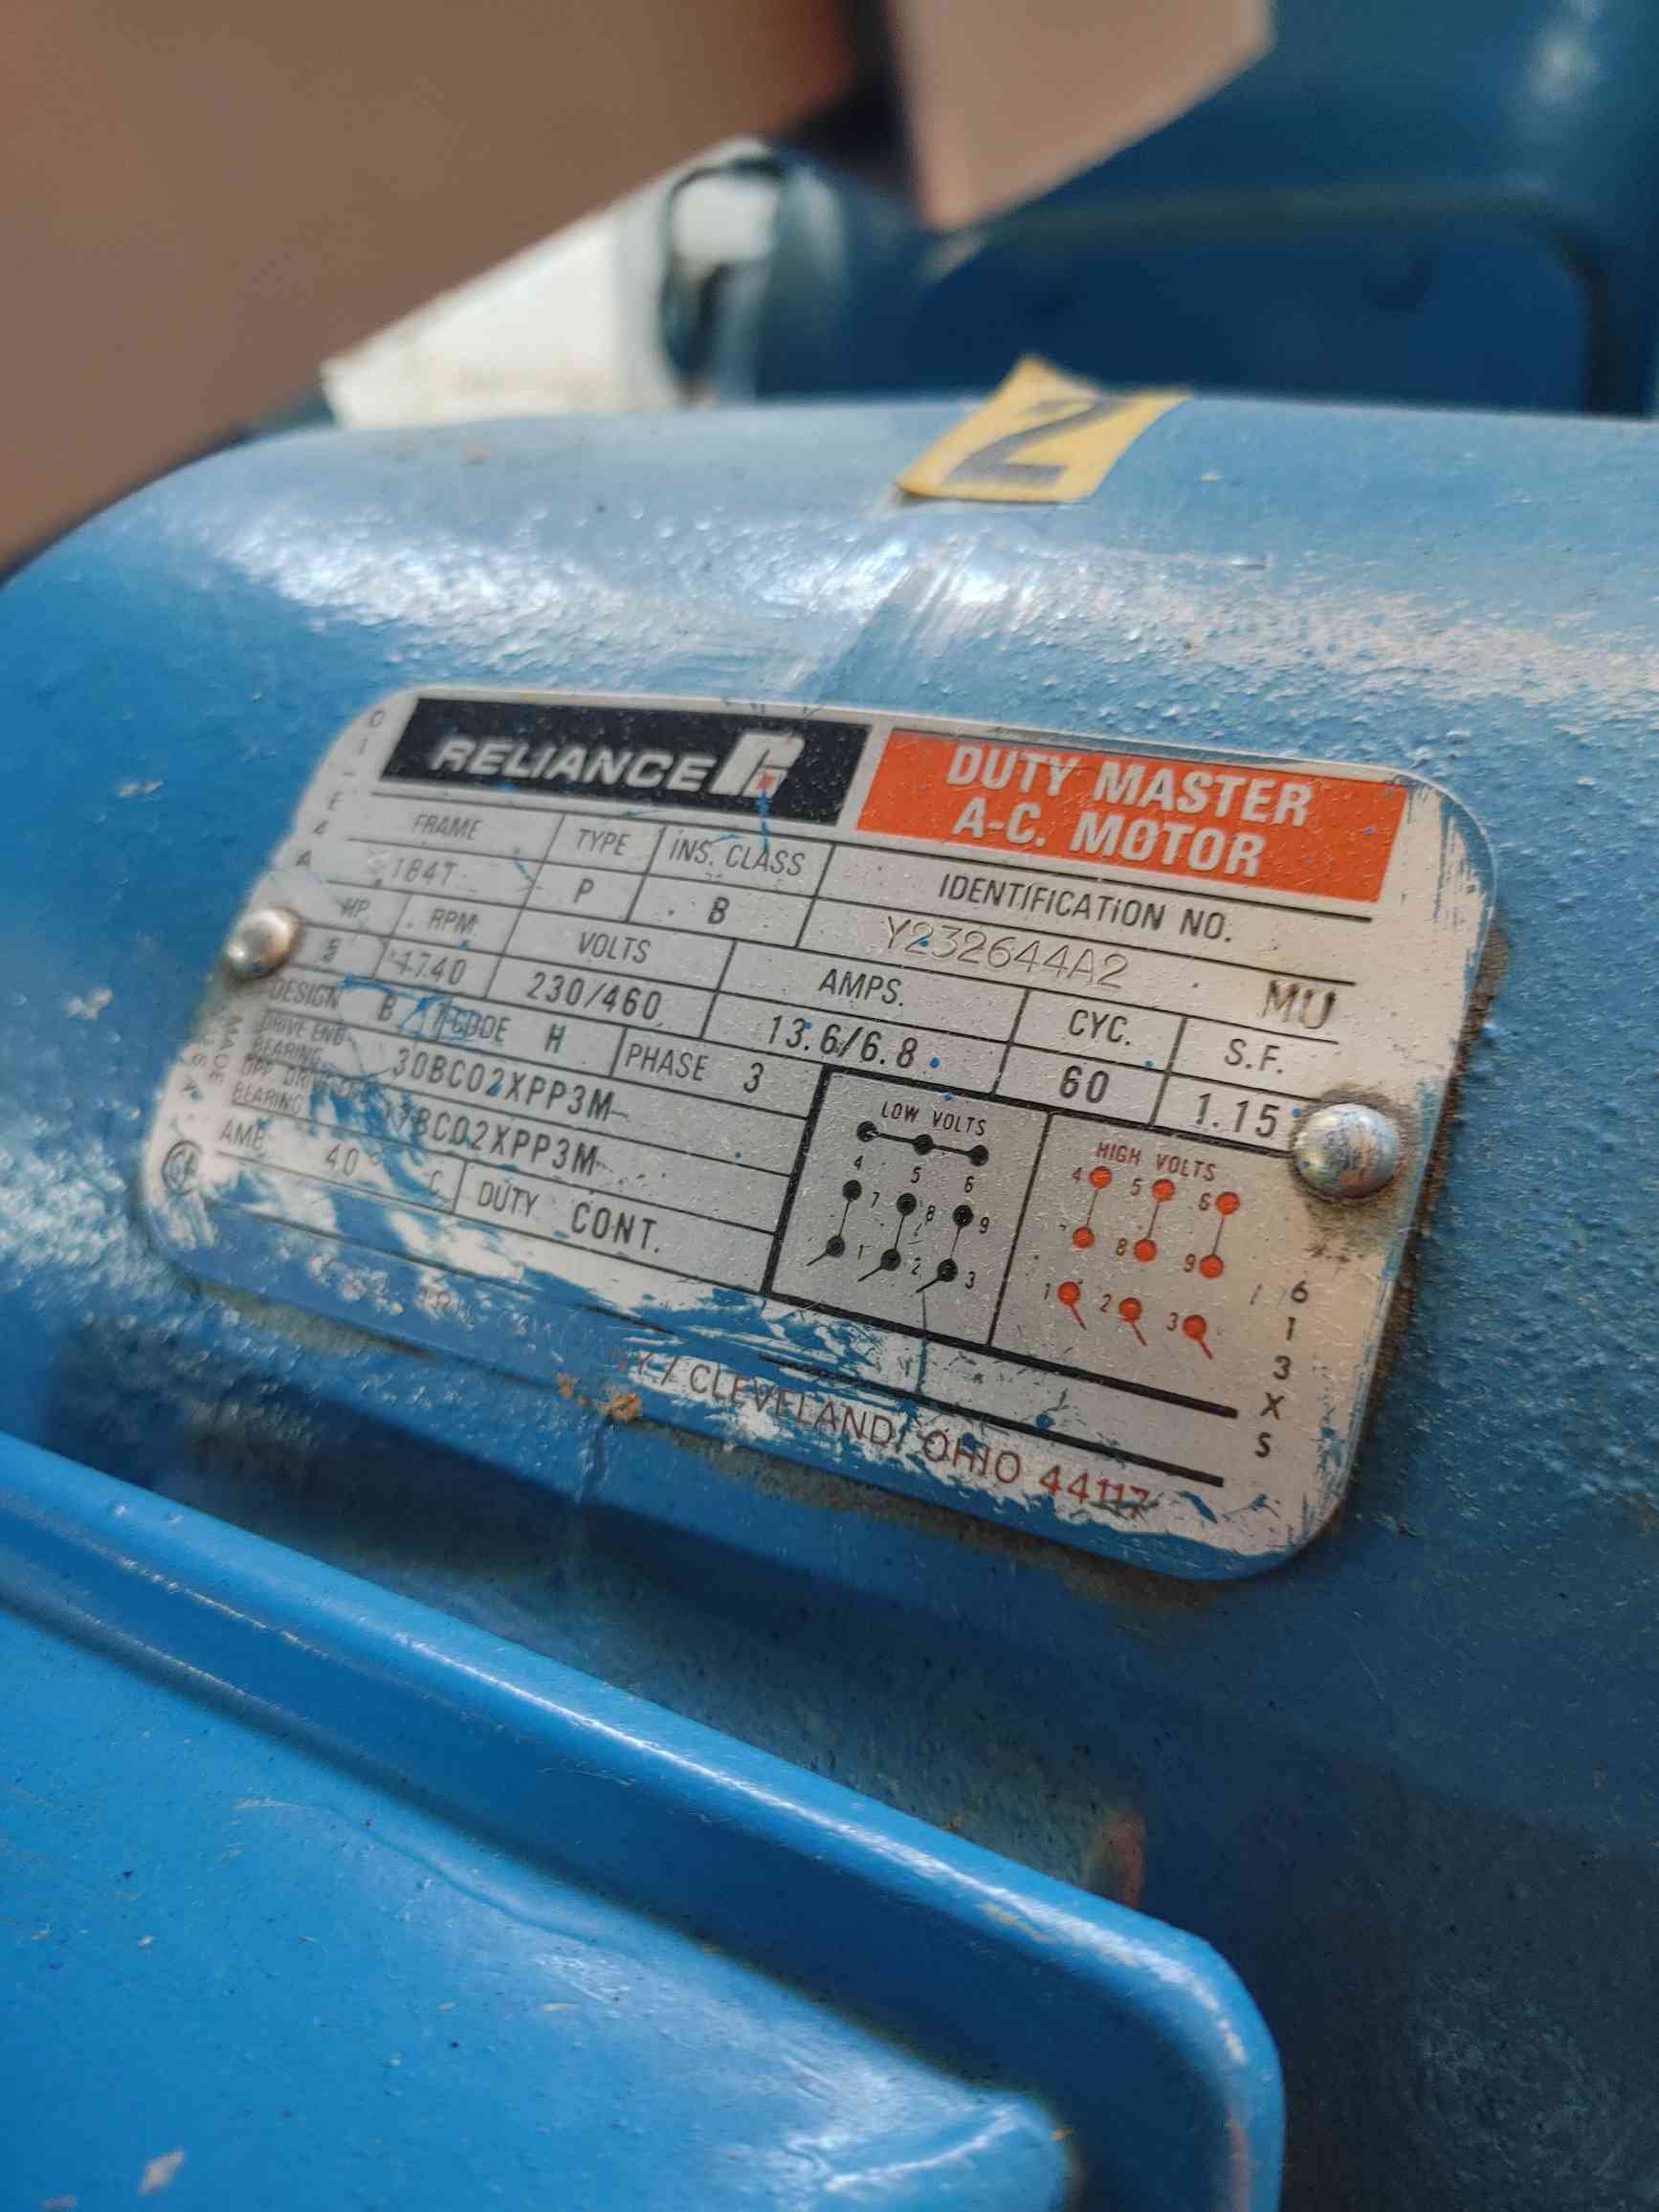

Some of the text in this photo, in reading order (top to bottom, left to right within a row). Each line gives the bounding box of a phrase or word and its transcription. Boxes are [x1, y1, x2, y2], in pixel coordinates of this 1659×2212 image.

[431, 740, 718, 793] RELIANCE
[946, 745, 1314, 829] DUTY MASTER
[412, 813, 483, 841] FRAME
[576, 829, 630, 857] TYPE
[952, 796, 1268, 879] A-C. MOTOR
[393, 857, 457, 887] 184T
[670, 837, 806, 876] INS. CLASS
[340, 897, 371, 918] HP
[573, 878, 595, 904] P
[939, 873, 1233, 944] IDENTIFICATION NO.
[430, 908, 478, 935] RPM
[708, 896, 731, 925] B
[577, 931, 652, 964] VOLTS
[886, 916, 1130, 990] Y232644A2
[270, 979, 397, 1022] DESIGN B
[525, 971, 663, 1021] 230/460
[819, 967, 904, 1007] AMPS.
[311, 1023, 346, 1047] END
[544, 1023, 567, 1053] H
[768, 1014, 918, 1069] 13.6/6.8
[1068, 1009, 1133, 1047] CYC.
[251, 1036, 323, 1065] BEARING
[624, 1043, 763, 1094] PHASE 3
[1224, 1038, 1284, 1074] S.F.
[232, 1082, 303, 1117] BEARING
[1059, 1065, 1110, 1104] 60
[881, 1101, 987, 1137] LOW VOLTS
[1195, 1093, 1281, 1139] 1.15
[325, 1142, 360, 1178] 40
[852, 1155, 975, 1194] 4 5 6
[1096, 1140, 1217, 1182] HIGH VOLTS
[1072, 1167, 1083, 1184] 4
[1131, 1178, 1141, 1196] 5
[477, 1181, 659, 1254] DUTY CONT.
[871, 1192, 989, 1235] 7 8 9
[911, 1257, 921, 1275] 2
[965, 1272, 976, 1290] 3
[1116, 1237, 1196, 1272] 8 9
[1044, 1283, 1179, 1331] 1 2 3
[922, 1429, 1021, 1484] OHIO
[1040, 1465, 1150, 1517] 44117
